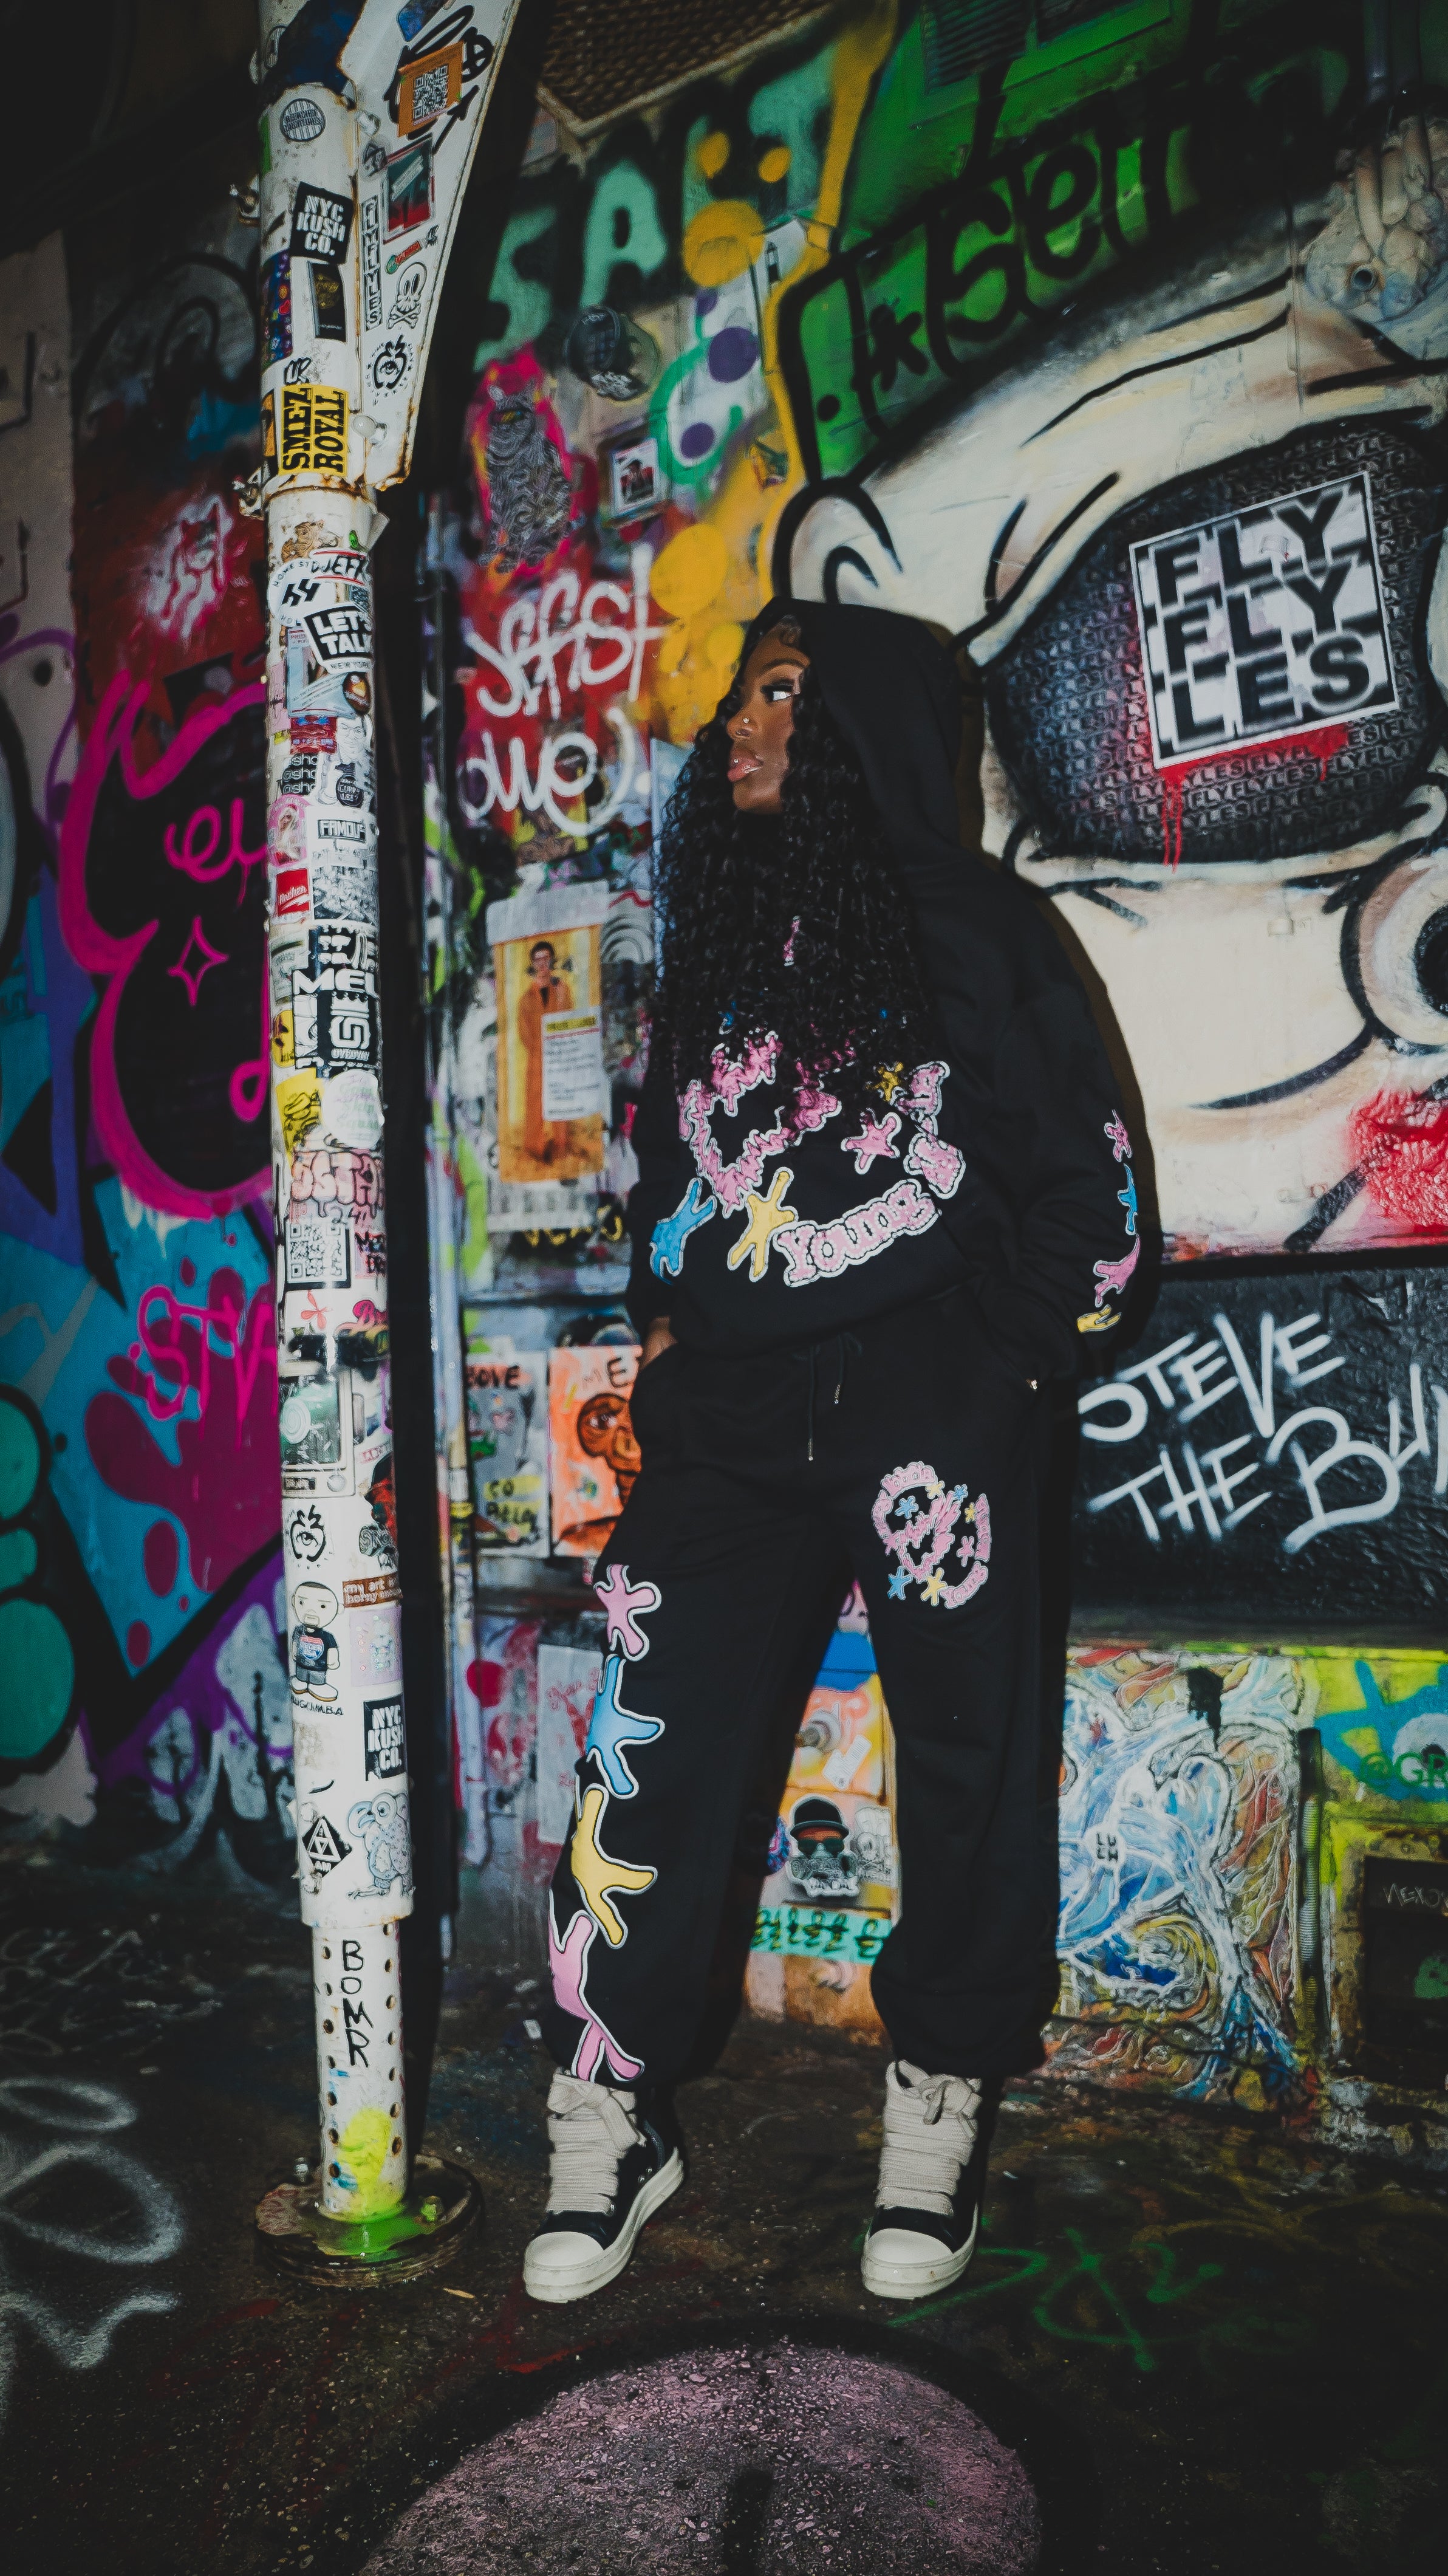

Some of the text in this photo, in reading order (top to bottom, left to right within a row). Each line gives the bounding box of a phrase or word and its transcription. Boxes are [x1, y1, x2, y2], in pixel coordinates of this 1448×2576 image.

[296, 211, 347, 242] KUSH
[304, 196, 344, 221] NYC
[305, 232, 335, 255] CO.
[313, 390, 347, 473] ROYAL
[1152, 486, 1346, 608] FLY
[320, 632, 372, 655] TAL
[1163, 561, 1353, 676] FLY
[1171, 632, 1372, 752] LES
[774, 1180, 940, 1284] Young
[1087, 1434, 1272, 1543] THE
[368, 1724, 404, 1753] KUSH
[372, 1704, 401, 1728] NYC
